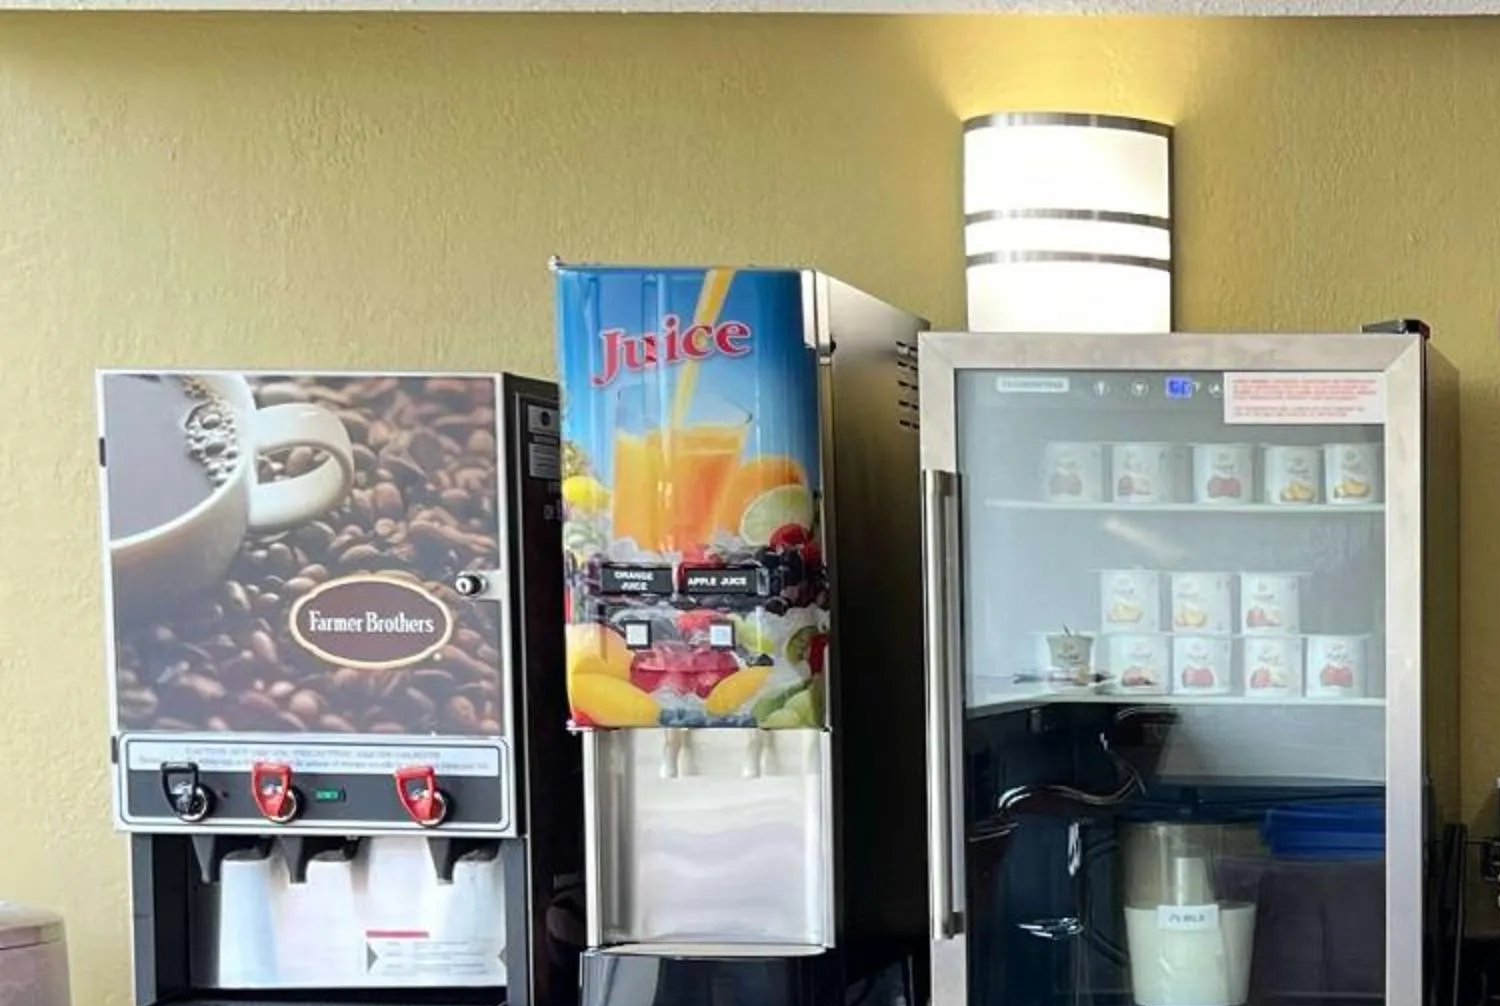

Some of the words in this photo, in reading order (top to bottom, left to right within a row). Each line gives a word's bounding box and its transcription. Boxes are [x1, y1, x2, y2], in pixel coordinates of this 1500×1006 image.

[590, 313, 753, 388] Juice
[613, 571, 654, 581] ORANGE
[687, 576, 717, 586] APPLE
[720, 576, 747, 586] JUICE
[620, 581, 648, 591] JUICE
[309, 610, 363, 632] Farmer
[365, 610, 435, 633] Brothers
